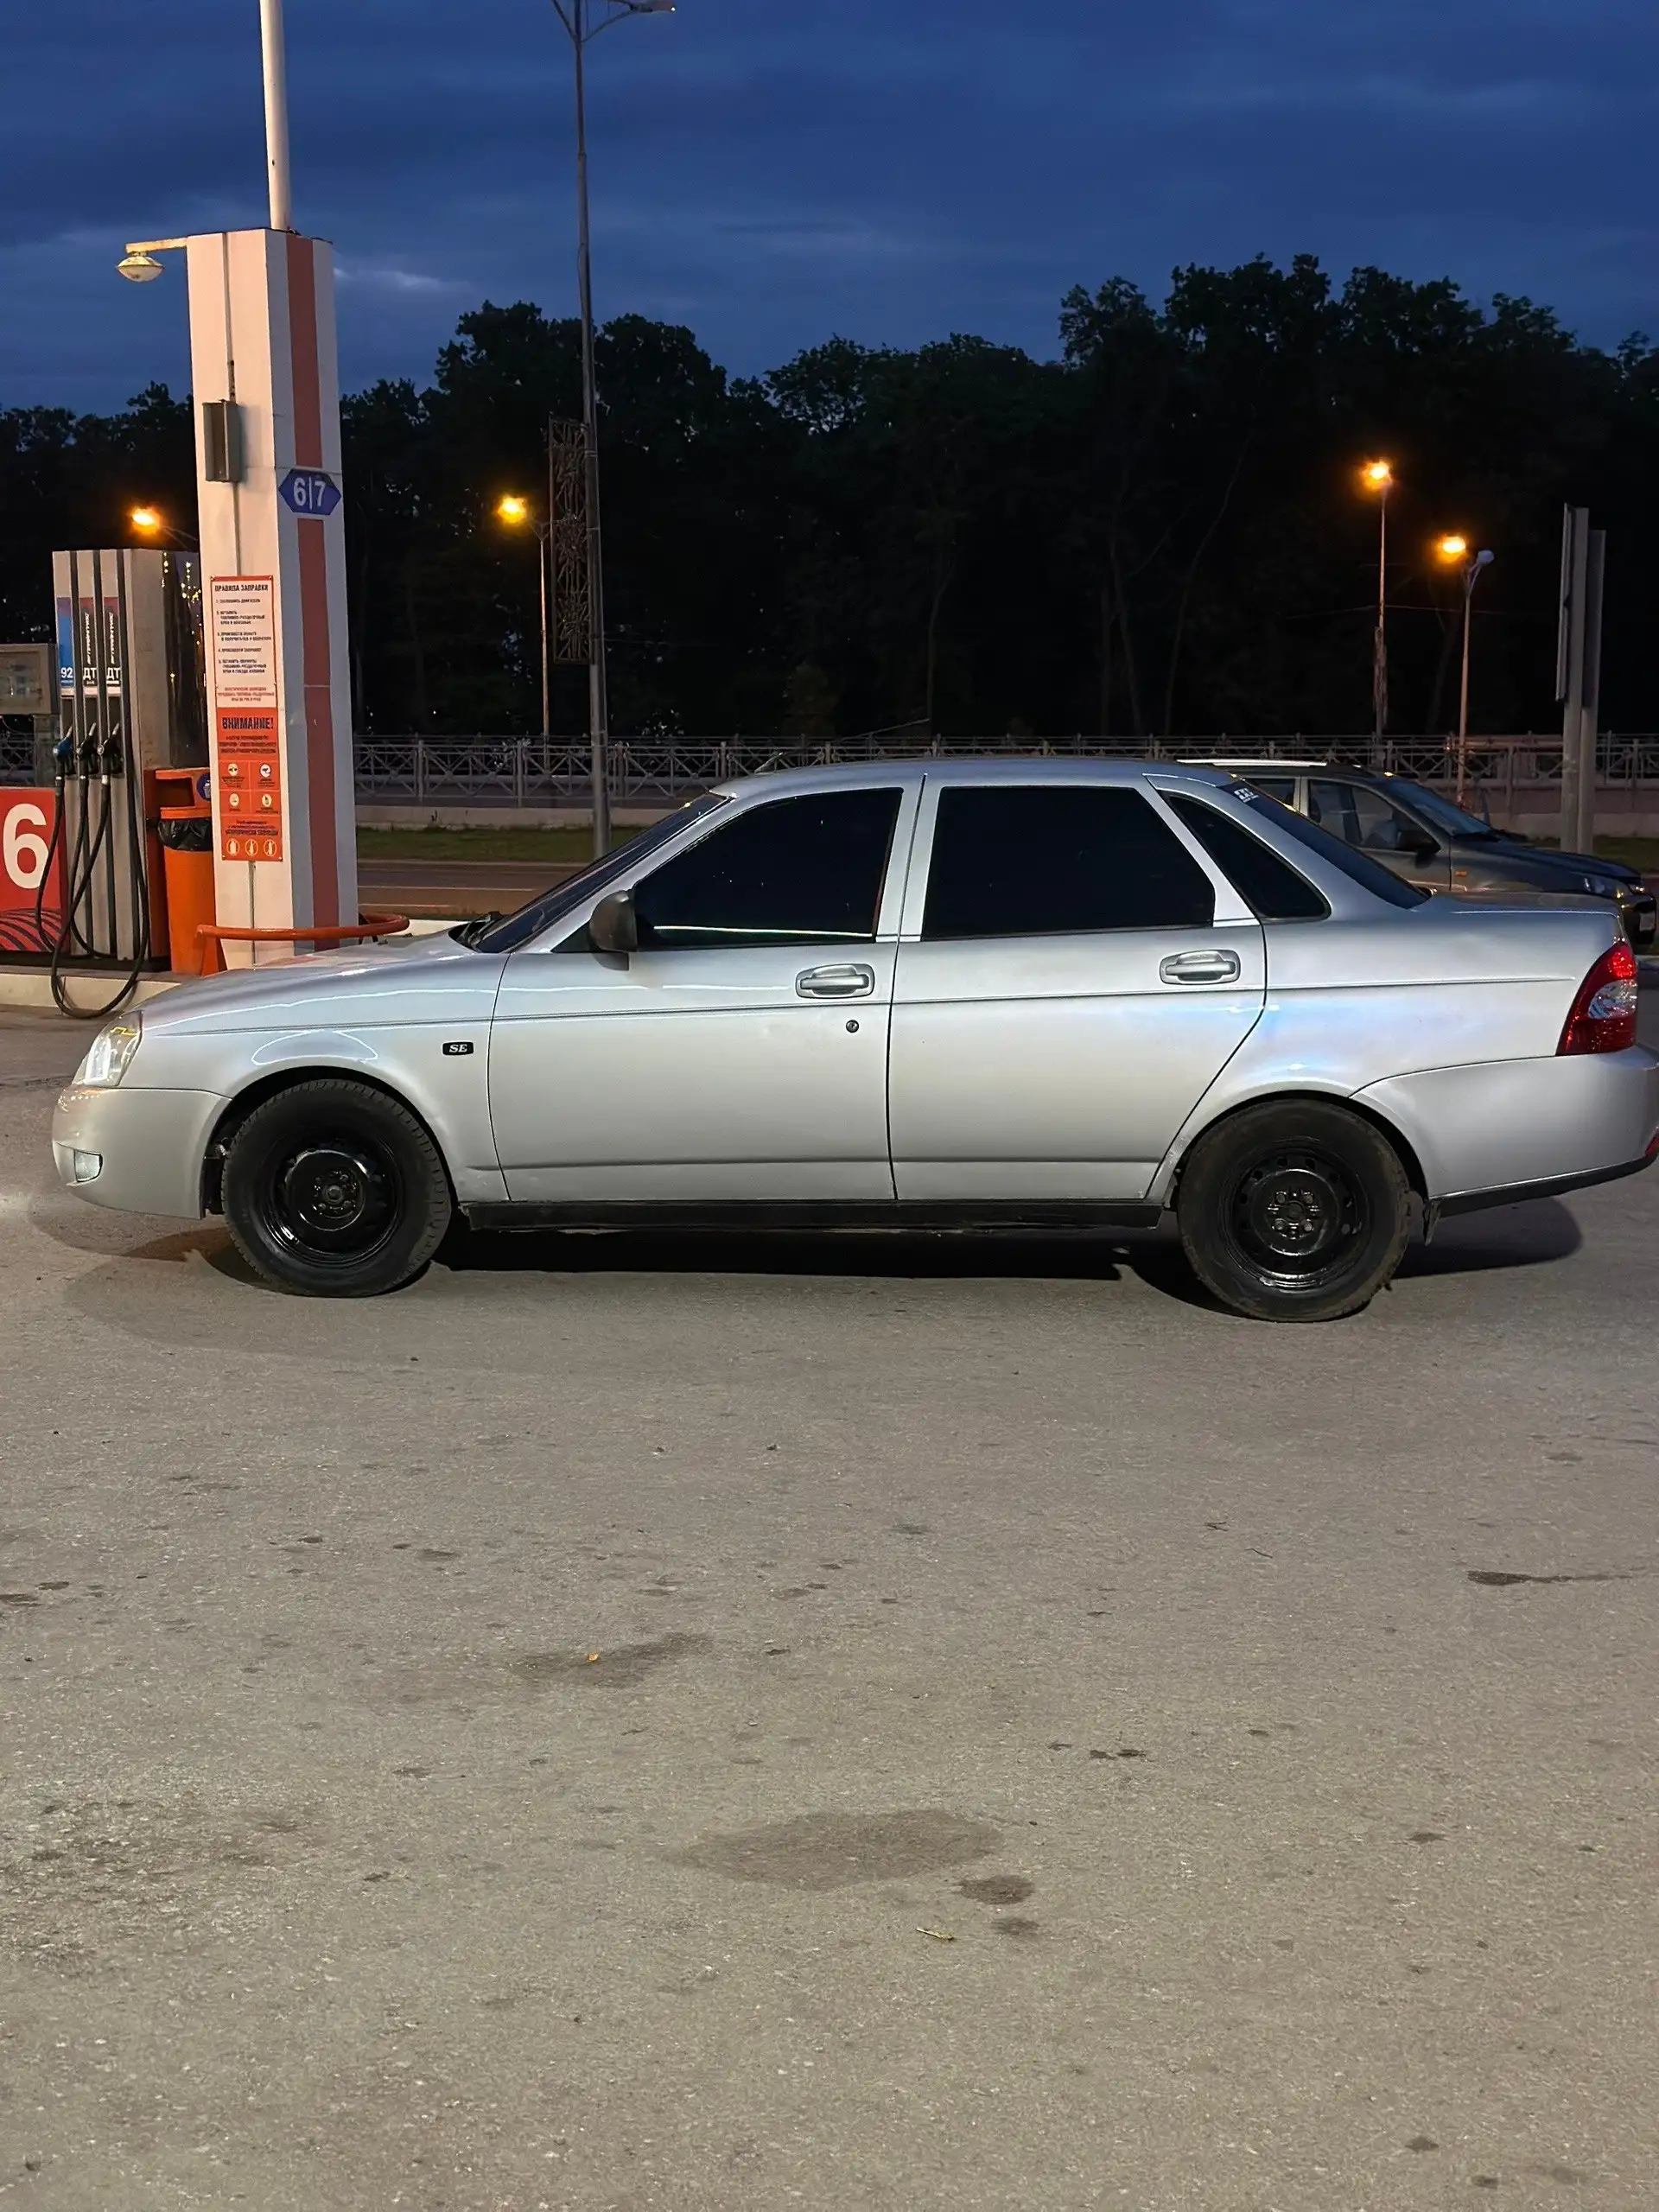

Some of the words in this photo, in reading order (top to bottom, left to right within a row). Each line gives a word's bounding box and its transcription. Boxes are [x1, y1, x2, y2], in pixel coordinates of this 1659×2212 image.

[60, 667, 73, 678] 92
[83, 667, 98, 680] ДТ
[106, 667, 121, 680] ДТ
[222, 717, 274, 729] ВНИМАНИЕ!
[3, 803, 49, 889] 6
[449, 1044, 467, 1052] SE
